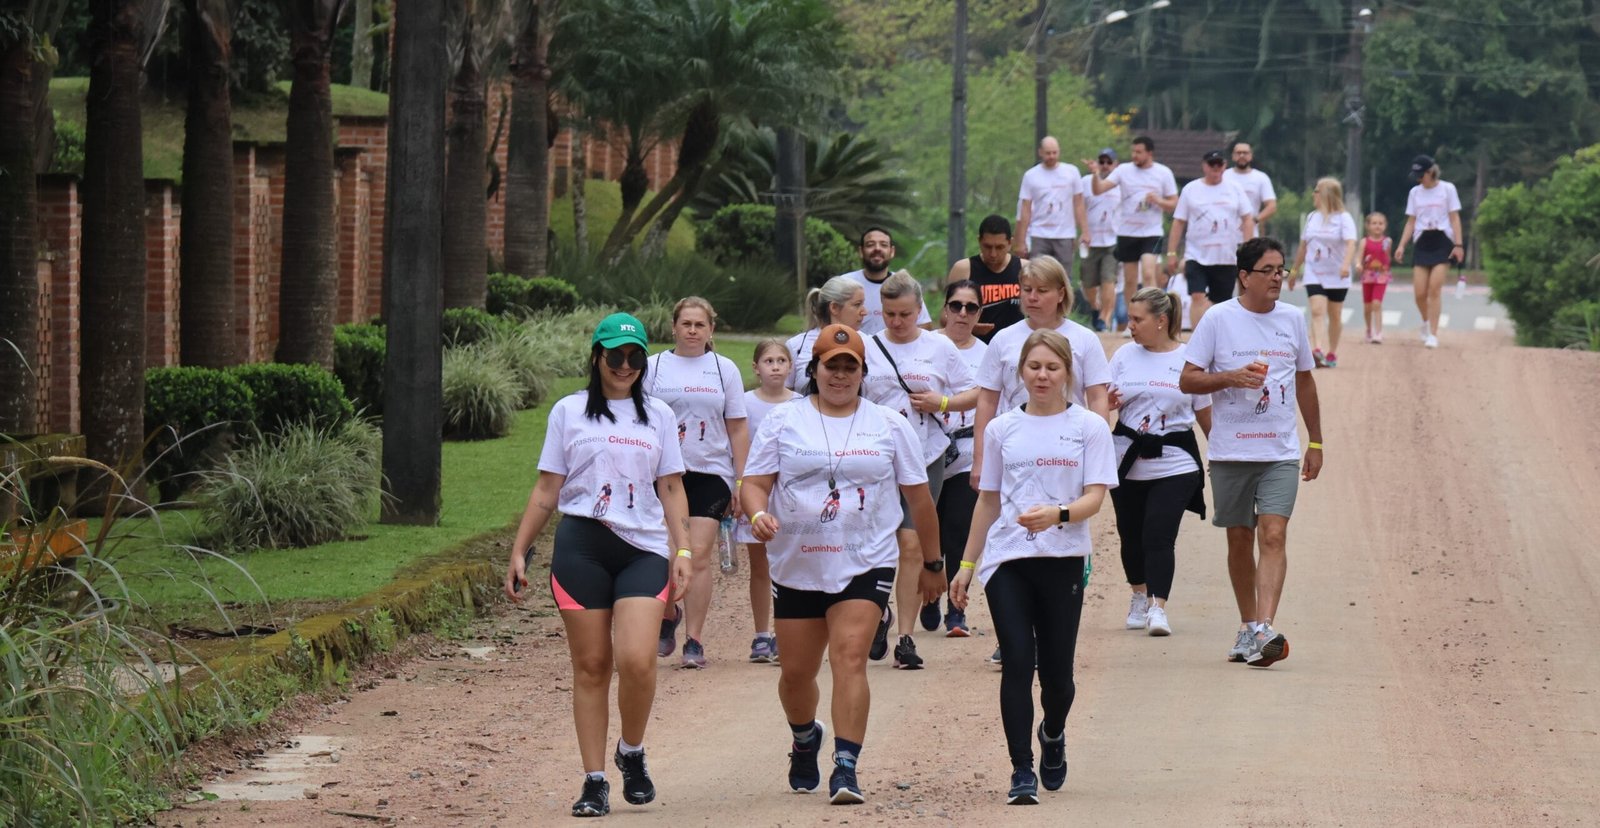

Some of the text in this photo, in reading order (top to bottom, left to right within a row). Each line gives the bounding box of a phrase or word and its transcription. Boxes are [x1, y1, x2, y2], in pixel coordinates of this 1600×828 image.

[620, 324, 636, 332] NYC
[1235, 431, 1277, 439] Caminhada
[608, 434, 652, 450] Ciclístico
[1036, 456, 1079, 467] Ciclístico
